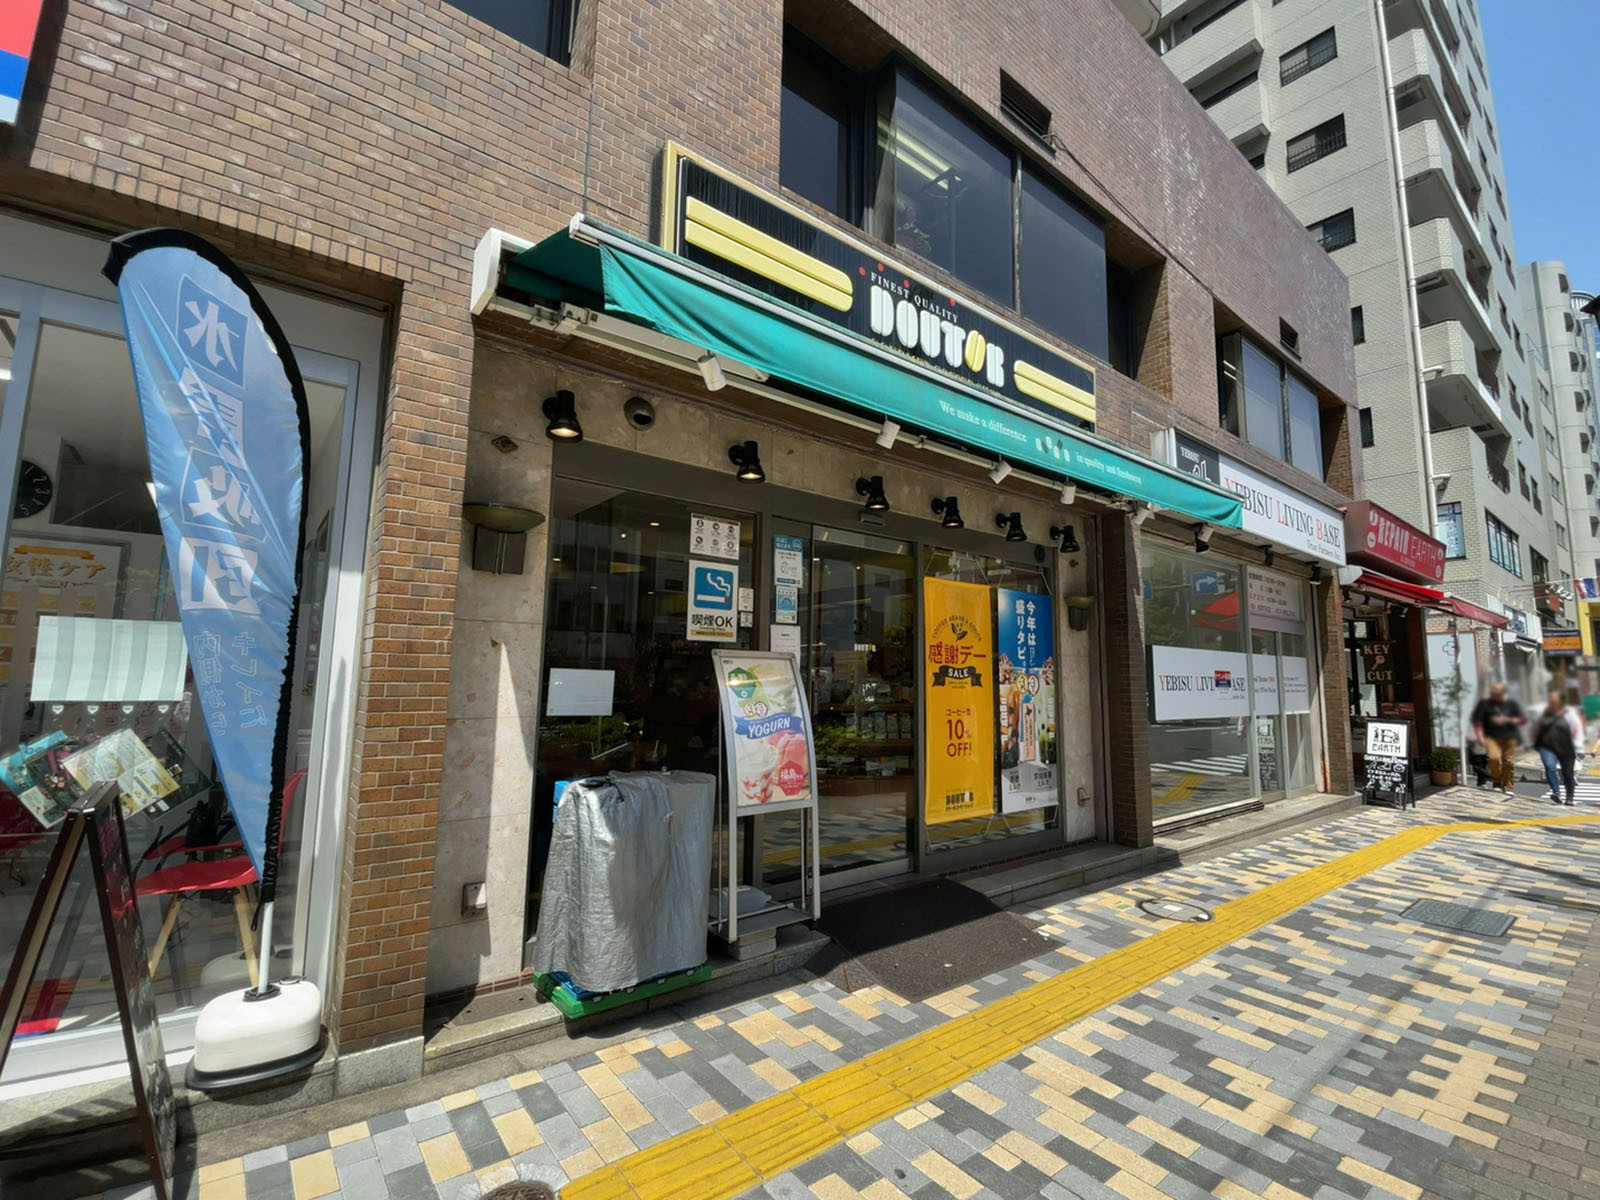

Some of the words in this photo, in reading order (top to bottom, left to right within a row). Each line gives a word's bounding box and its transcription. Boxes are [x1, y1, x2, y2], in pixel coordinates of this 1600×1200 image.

[870, 272, 911, 299] FINEST
[914, 294, 959, 323] QUALITY
[870, 285, 1005, 388] DOUTOR
[938, 400, 955, 416] We
[957, 406, 982, 426] make
[988, 419, 1028, 443] difference
[1276, 500, 1314, 538] LIVING
[1316, 518, 1341, 548] BASE
[1378, 516, 1410, 555] REPAIR
[1410, 535, 1438, 569] EARTH
[691, 613, 733, 628] 喫煙OK
[1026, 601, 1037, 646] 今年は
[928, 641, 987, 665] 感謝デー
[1363, 644, 1390, 655] KEY
[947, 668, 969, 678] SALE
[1158, 674, 1193, 692] YEBISU
[1231, 676, 1246, 692] ASE
[1366, 670, 1393, 681] CUT
[748, 716, 791, 739] YOGURN
[946, 742, 972, 757] OFF!
[1371, 743, 1401, 754] EARTH
